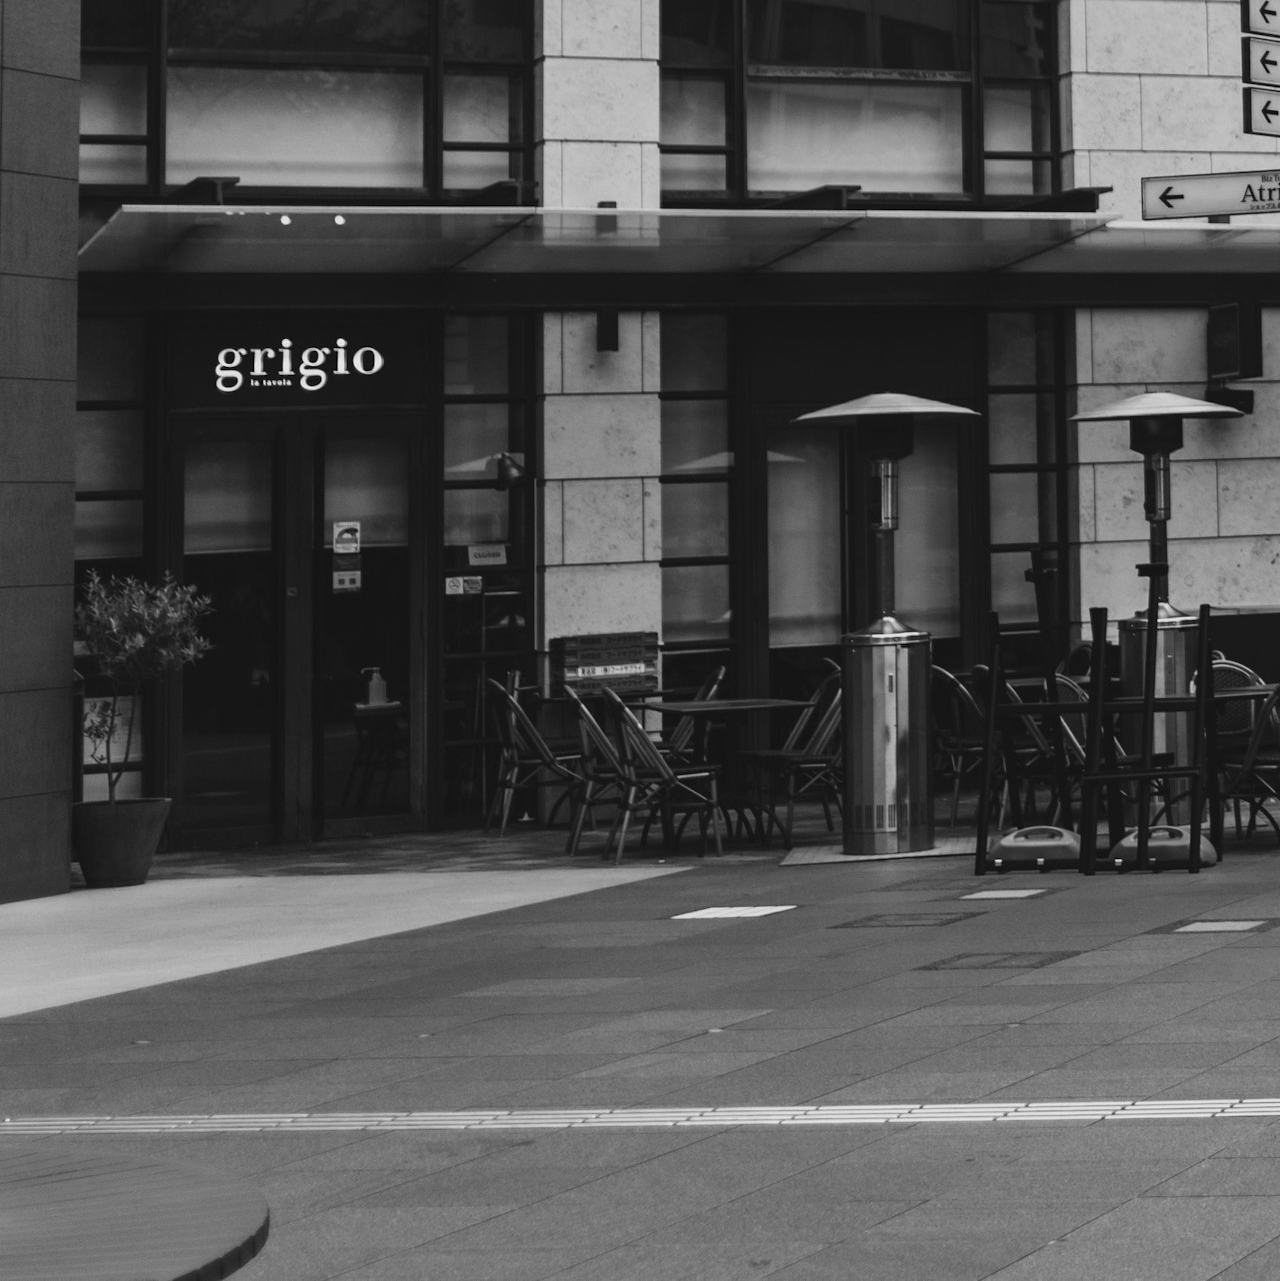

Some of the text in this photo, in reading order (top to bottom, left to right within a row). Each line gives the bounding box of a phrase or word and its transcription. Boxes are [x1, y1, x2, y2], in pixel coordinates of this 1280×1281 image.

[1261, 174, 1272, 183] Biz
[215, 337, 385, 393] grigio
[250, 378, 292, 387] la tavola
